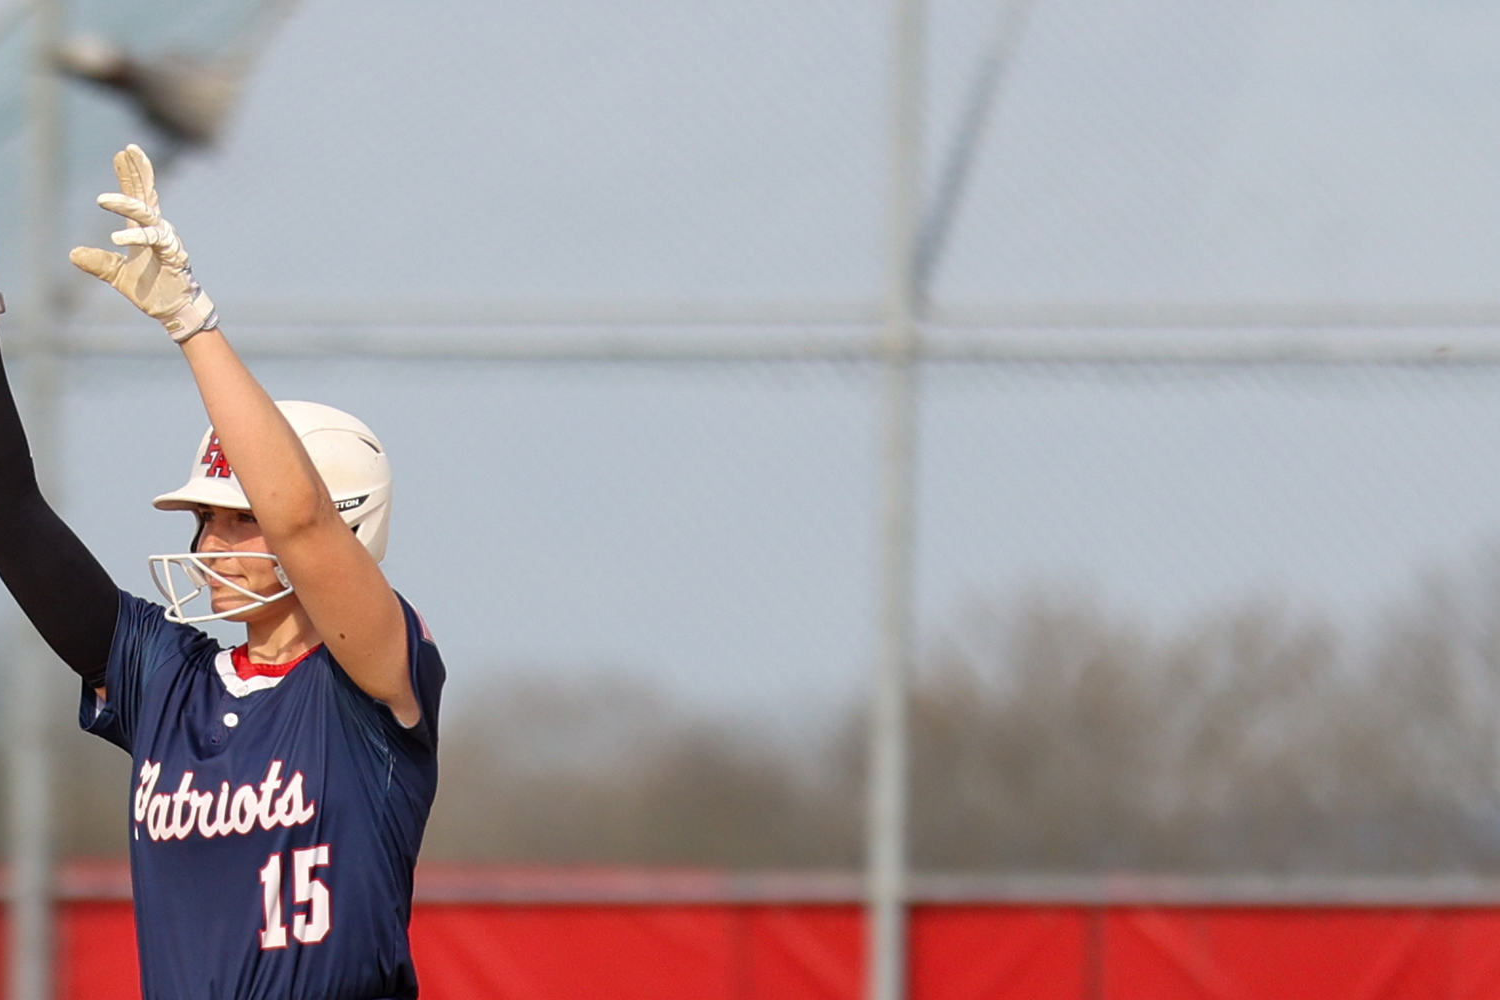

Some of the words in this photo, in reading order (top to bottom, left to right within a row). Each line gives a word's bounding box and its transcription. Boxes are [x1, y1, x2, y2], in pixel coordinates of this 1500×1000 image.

[334, 499, 360, 509] STON
[133, 758, 314, 842] Patriots
[259, 843, 331, 950] 15
